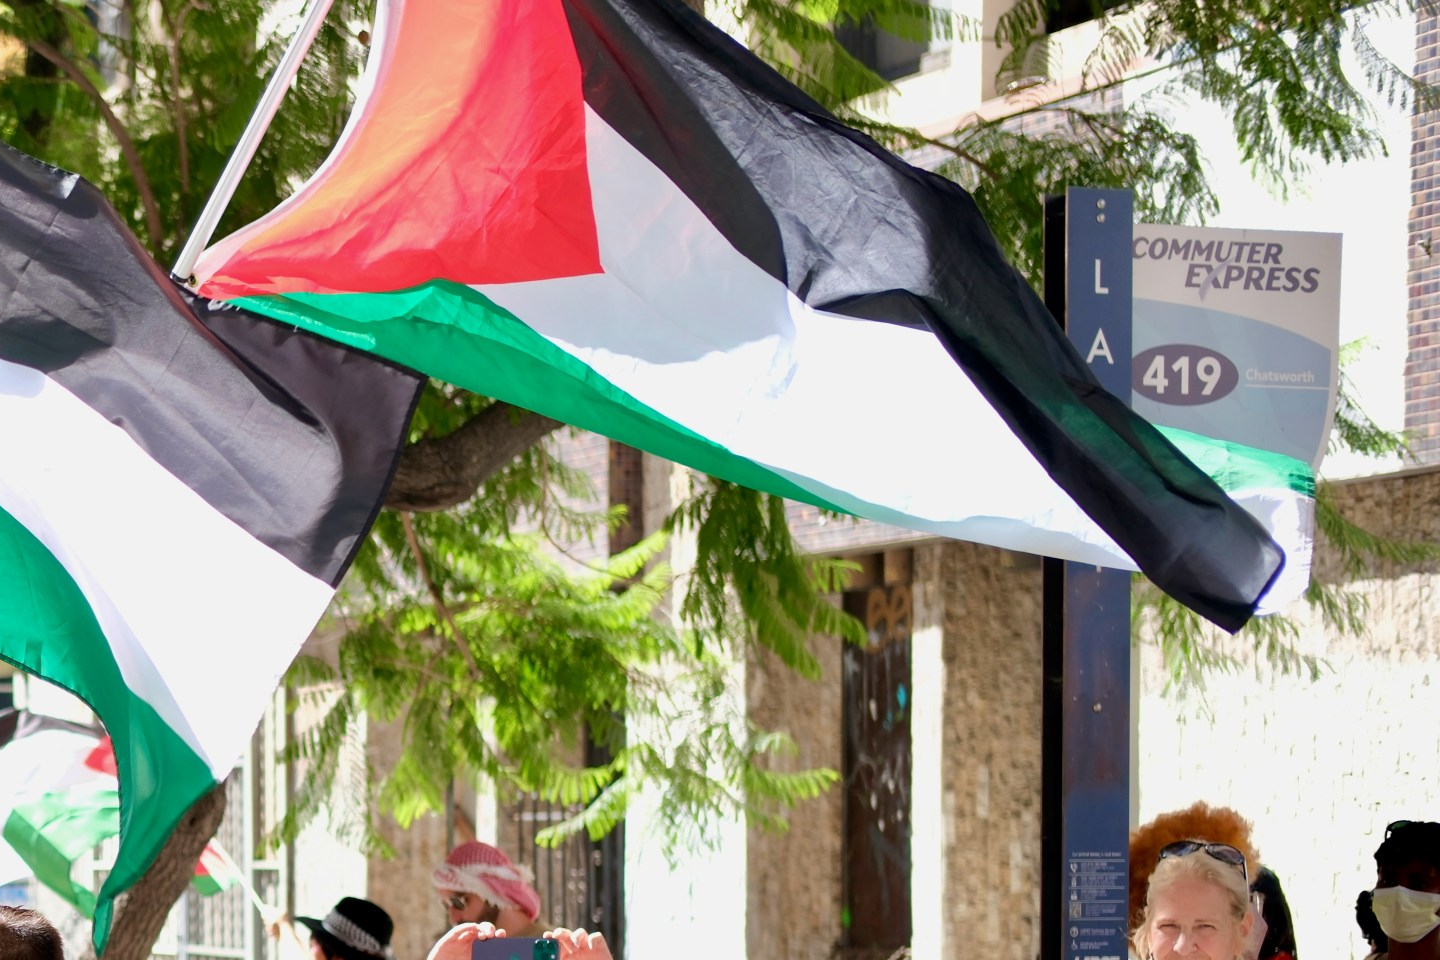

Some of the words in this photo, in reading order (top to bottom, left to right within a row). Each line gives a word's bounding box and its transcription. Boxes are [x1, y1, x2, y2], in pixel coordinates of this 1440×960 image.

[1132, 237, 1283, 264] COMMUTER
[1185, 263, 1320, 293] EXPRESS
[1143, 354, 1221, 396] 419
[1245, 368, 1315, 383] Chatsworth
